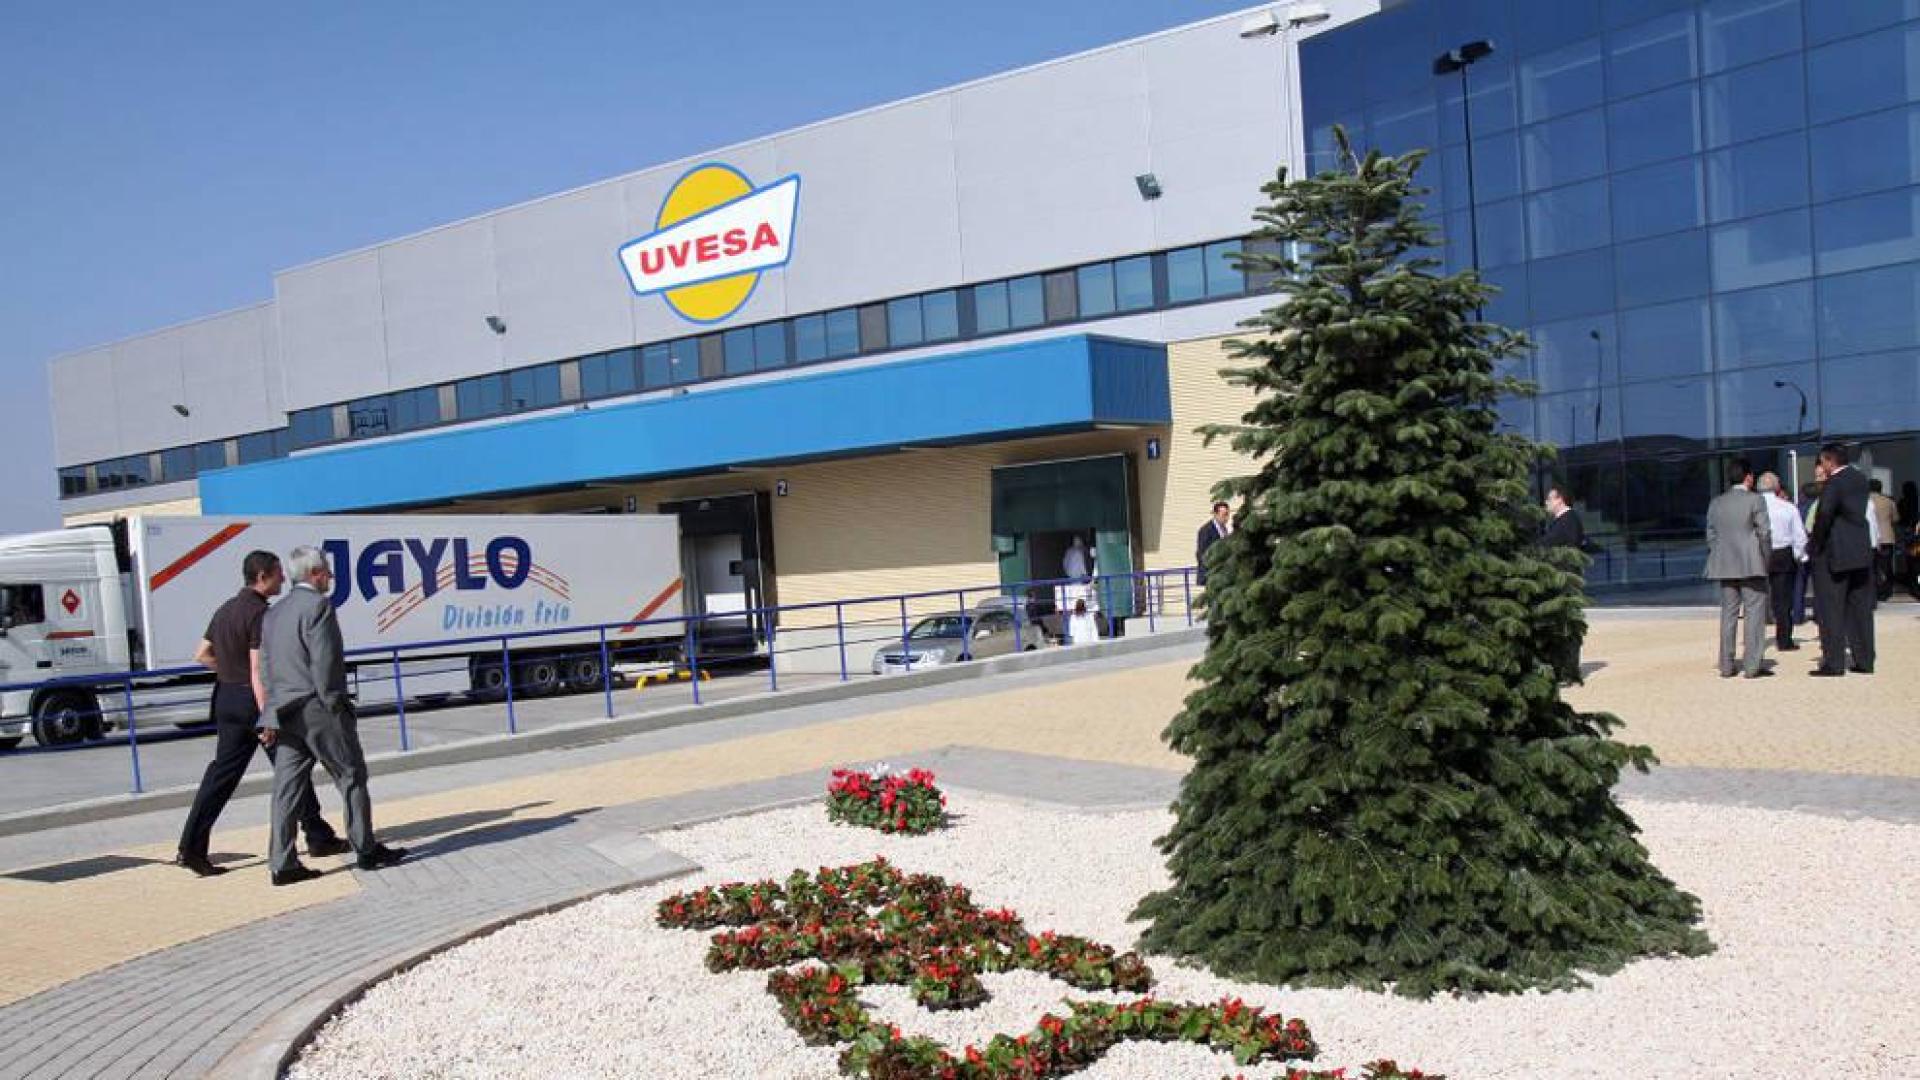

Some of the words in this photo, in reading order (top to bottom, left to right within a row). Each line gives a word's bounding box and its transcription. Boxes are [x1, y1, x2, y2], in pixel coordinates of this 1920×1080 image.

[640, 221, 779, 274] UVESA
[322, 536, 531, 608] JAYLO
[443, 604, 524, 630] División
